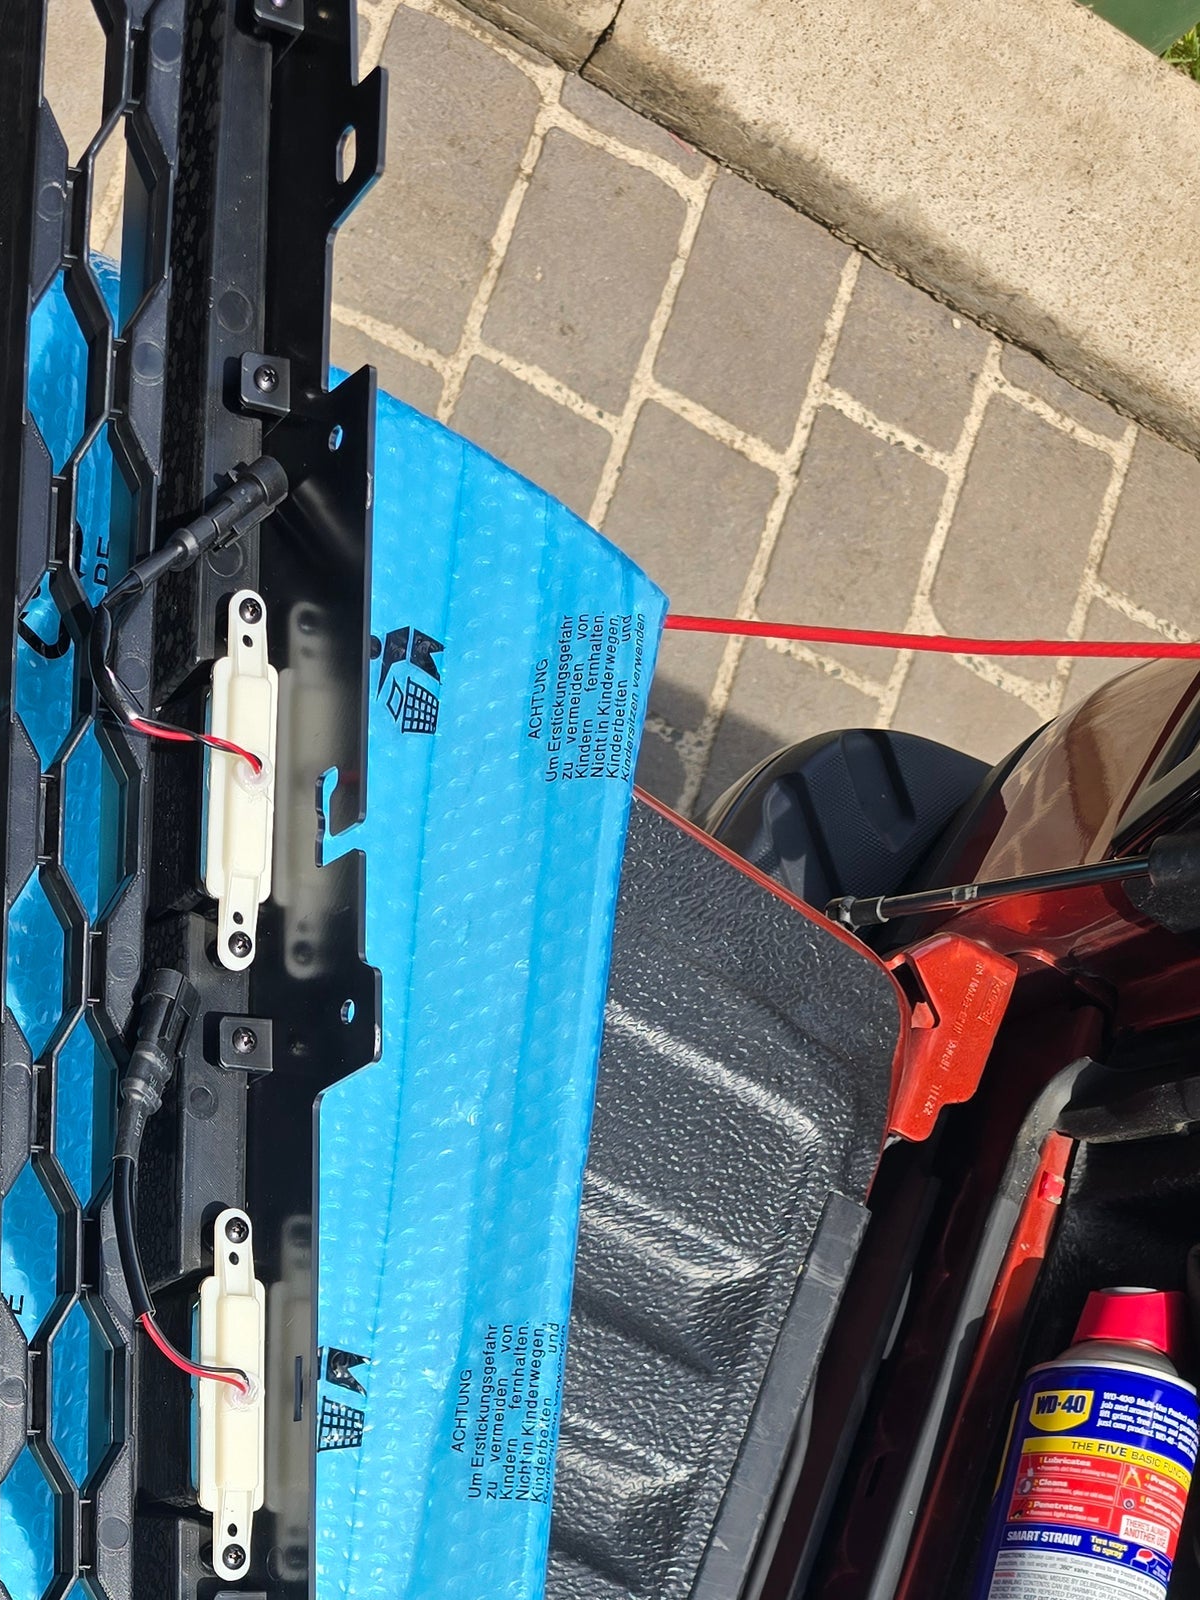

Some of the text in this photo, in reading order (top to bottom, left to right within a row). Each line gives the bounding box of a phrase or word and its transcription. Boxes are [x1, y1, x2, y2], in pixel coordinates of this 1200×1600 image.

[528, 658, 550, 739] ACHTUNG
[545, 615, 573, 781] Um Erstickungsgefahr
[562, 614, 589, 779] zu vermeiden von
[575, 611, 604, 778] Kindern fernhalten.
[590, 615, 620, 777] Nicht in Kinderwegen,
[605, 615, 631, 778] Kinderbetten und
[621, 613, 645, 782] Kindersitzen verwenden
[452, 1369, 473, 1452] ACHTUNG
[468, 1324, 497, 1497] Um Erstickungsgefahr
[487, 1325, 513, 1499] zu vermeiden von
[499, 1322, 529, 1499] Kindern fernhalten.
[515, 1323, 546, 1500] Nicht in Kinderwegen,
[548, 1323, 559, 1353] und
[1034, 1501, 1083, 1511] Penetrates
[1038, 1479, 1067, 1487] Cleans
[1043, 1456, 1091, 1466] Lubricates
[1071, 1440, 1093, 1450] THE
[1097, 1444, 1126, 1456] FIVE
[1131, 1449, 1161, 1467] BASIC
[1123, 1526, 1156, 1543] ANOTHER
[1007, 1530, 1081, 1545] SMART STRAW
